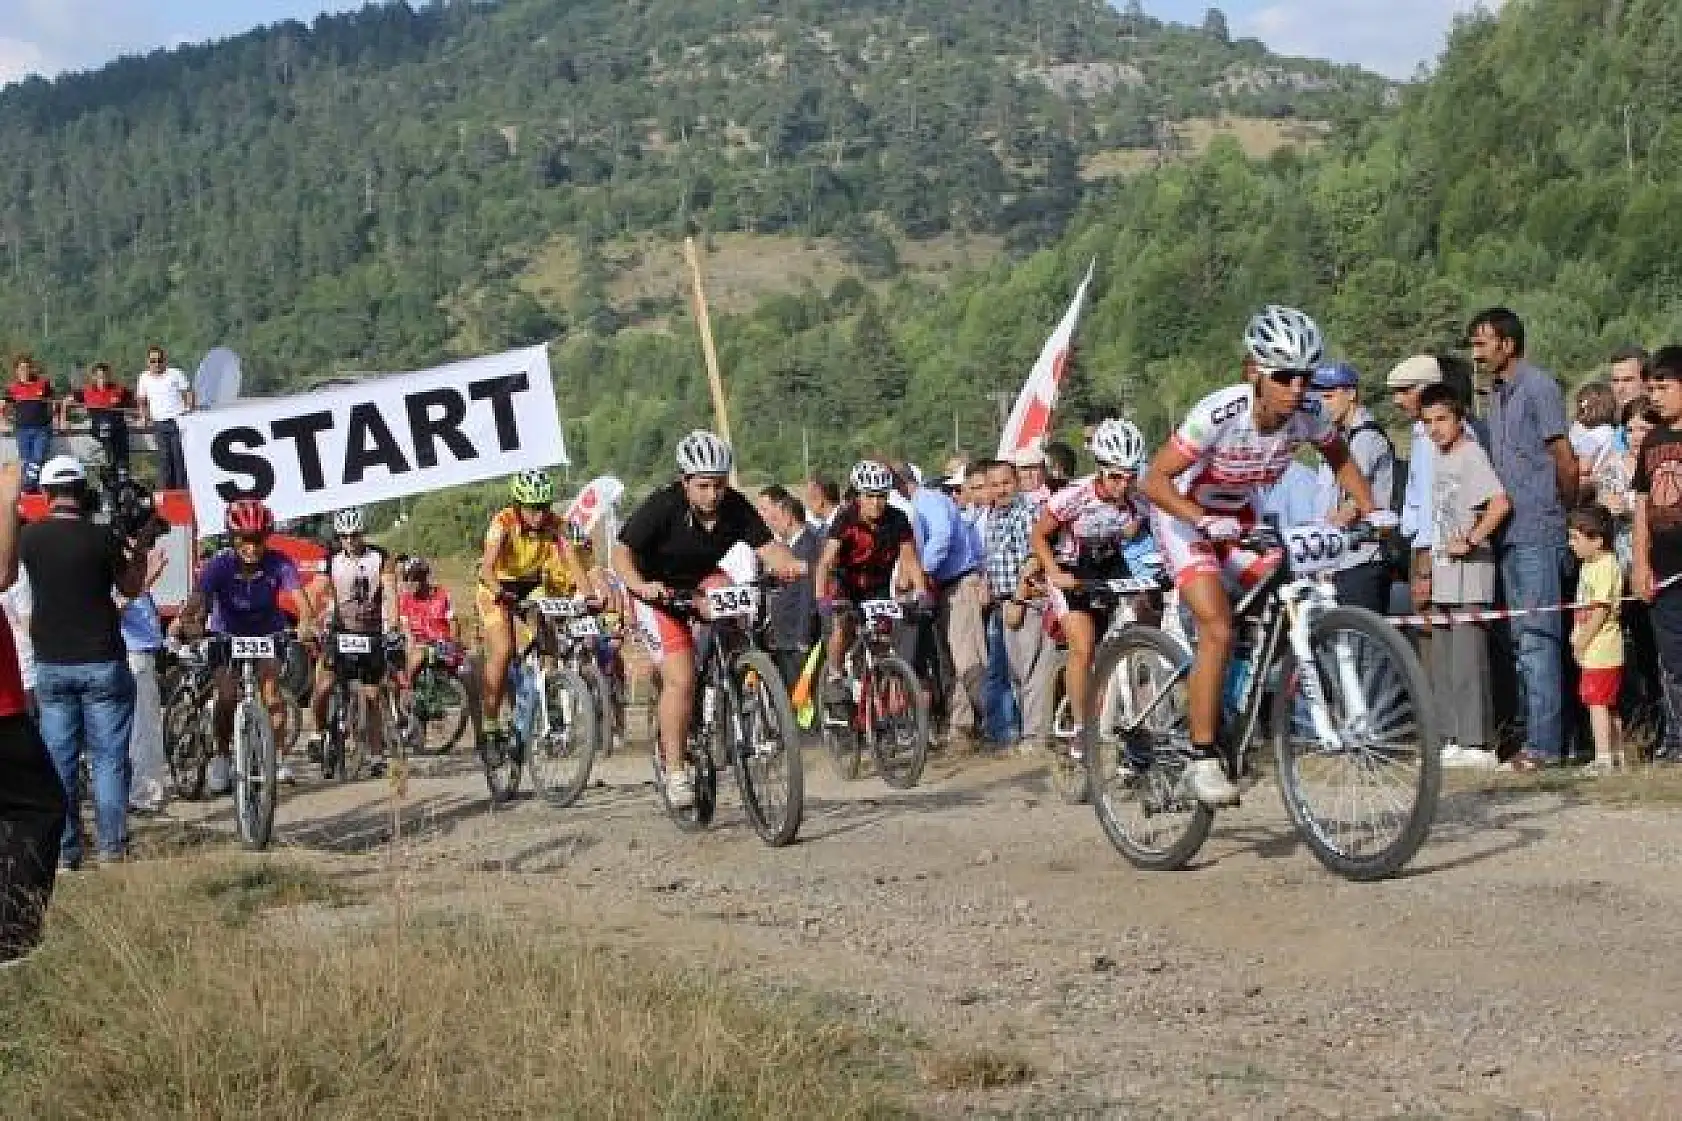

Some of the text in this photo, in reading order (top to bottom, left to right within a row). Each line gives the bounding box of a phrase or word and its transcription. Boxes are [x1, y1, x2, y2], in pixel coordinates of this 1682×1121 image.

[211, 371, 529, 502] START
[711, 590, 751, 612] 334
[236, 641, 272, 654] 335
